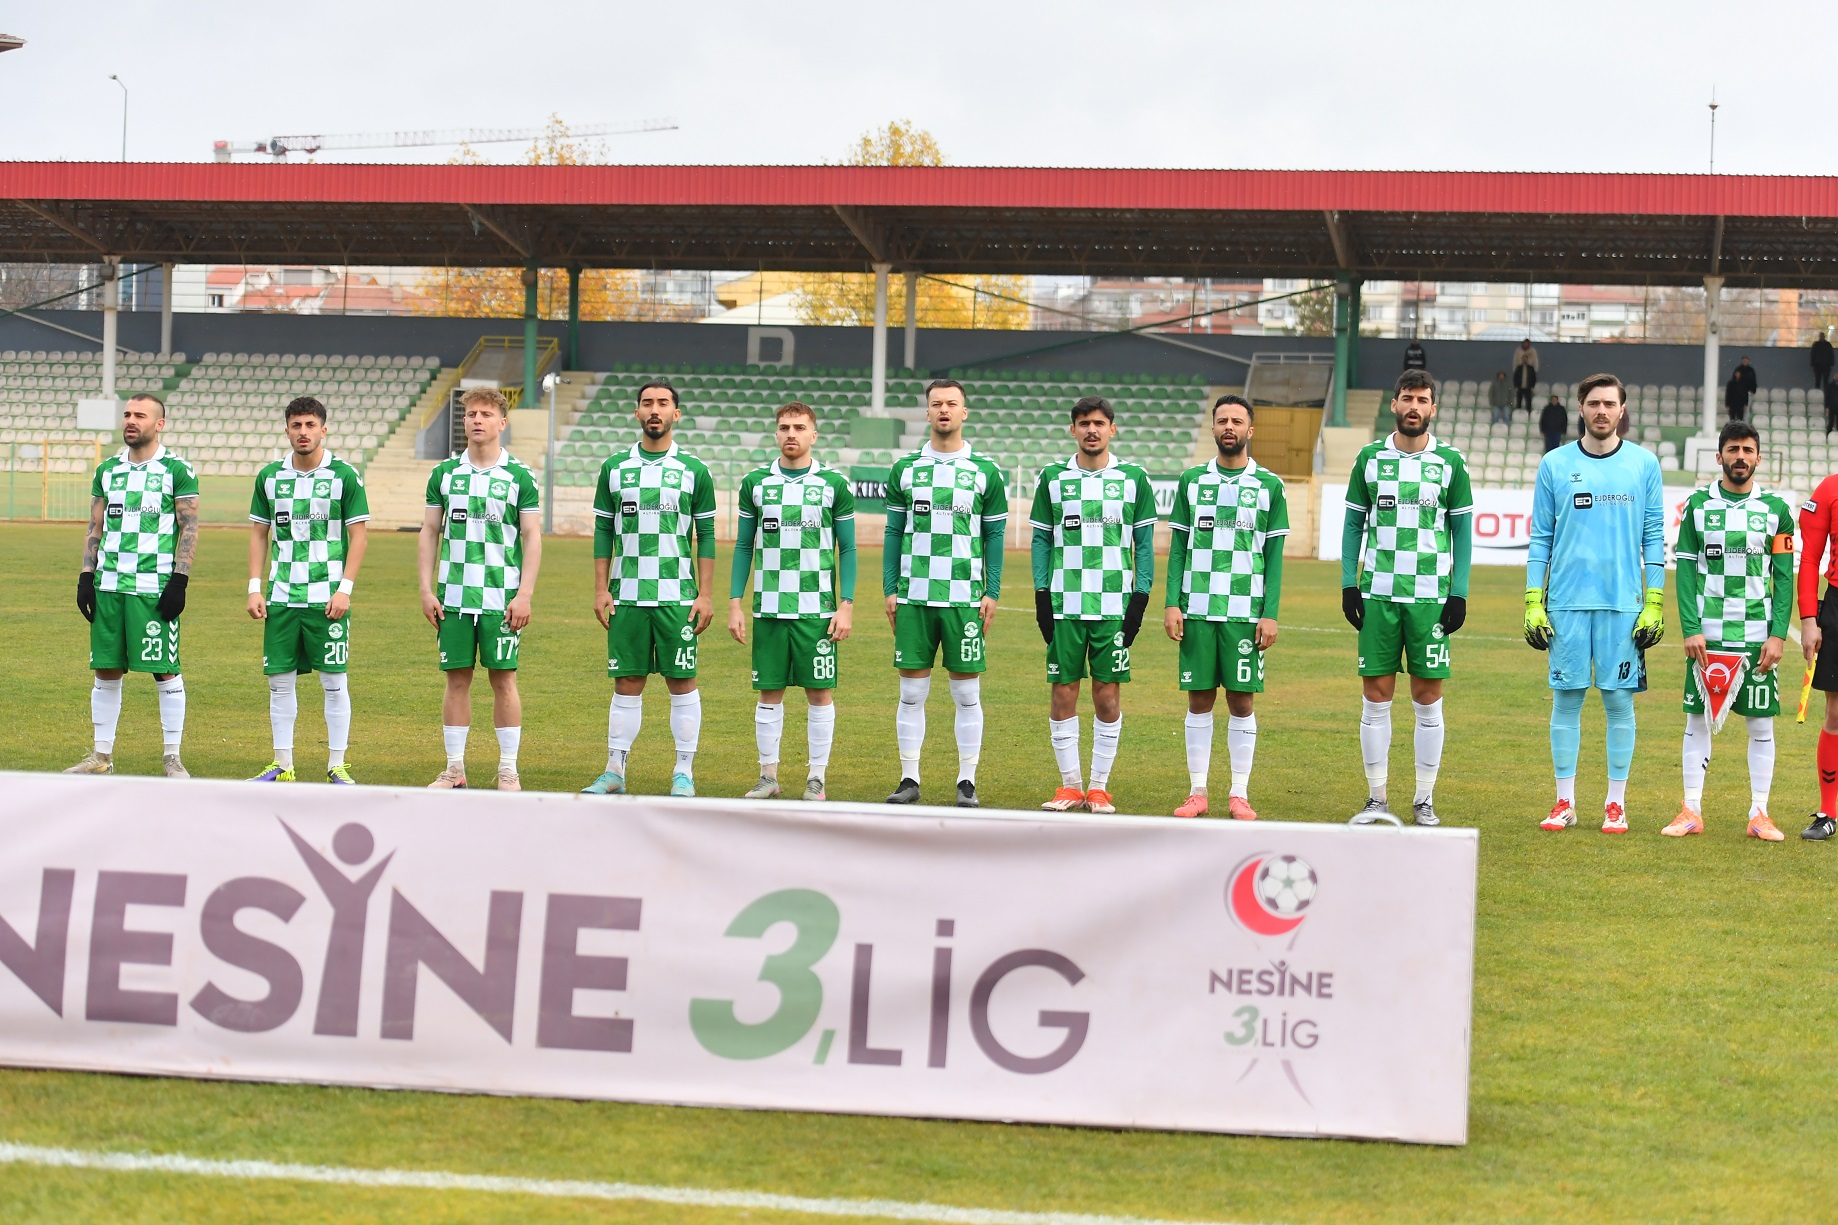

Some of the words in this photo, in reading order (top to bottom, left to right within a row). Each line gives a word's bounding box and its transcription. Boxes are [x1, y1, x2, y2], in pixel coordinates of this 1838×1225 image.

[746, 327, 795, 367] D
[1398, 498, 1438, 507] EJDEROĞLU
[1594, 494, 1635, 502] EJDEROĞLU
[1474, 513, 1532, 538] OT
[1784, 536, 1793, 551] C
[141, 637, 163, 661] 23
[324, 641, 346, 665] 20
[496, 636, 516, 660] 17
[674, 646, 695, 670] 45
[960, 637, 981, 662] 69
[1426, 643, 1451, 668] 54
[813, 655, 835, 680] 88
[1112, 648, 1130, 673] 32
[1237, 658, 1251, 683] 6
[1617, 661, 1631, 680] 13
[1746, 685, 1772, 710] 10
